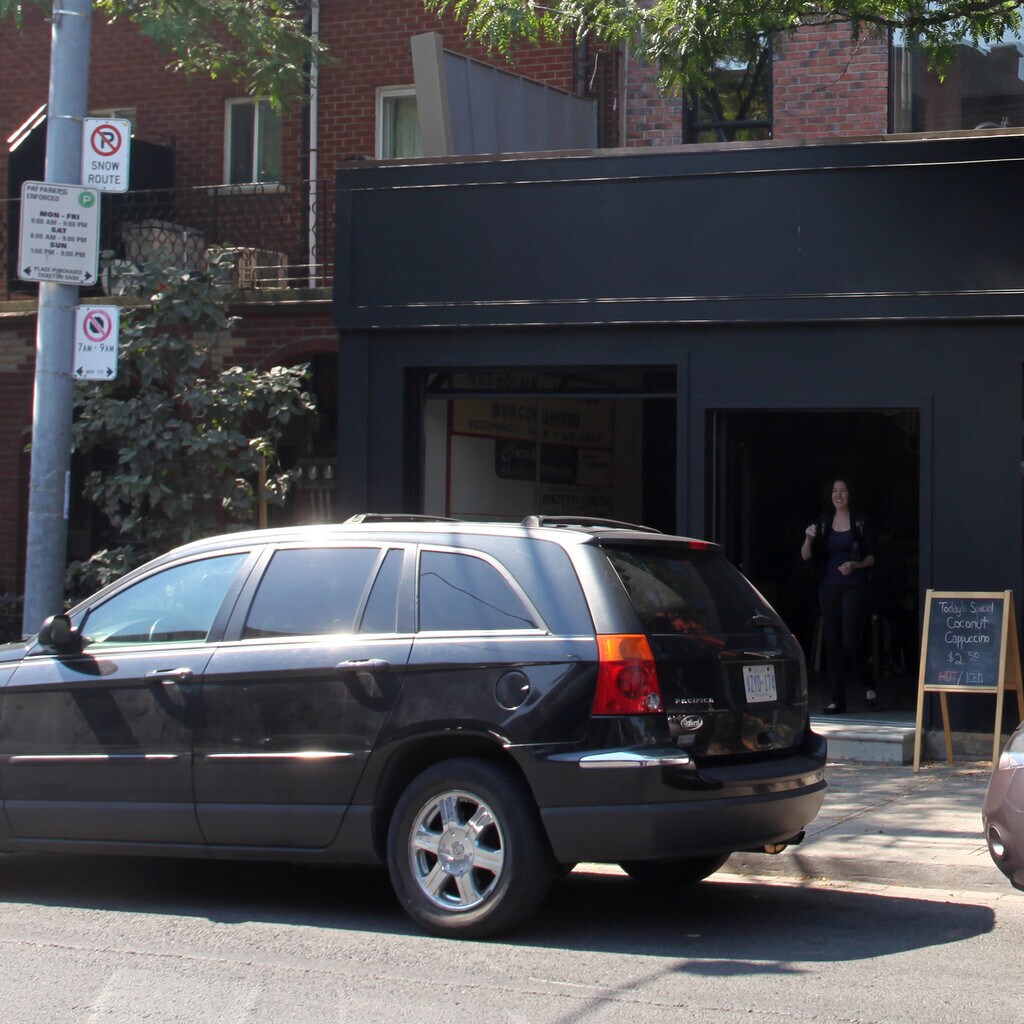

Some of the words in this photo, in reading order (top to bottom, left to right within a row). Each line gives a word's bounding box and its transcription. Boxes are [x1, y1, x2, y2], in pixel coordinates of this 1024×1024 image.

[91, 161, 119, 170] SNOW
[88, 174, 120, 184] ROUTE
[39, 187, 68, 195] PARKING
[26, 193, 60, 202] ENFORCED
[78, 343, 92, 352] 7AM
[100, 343, 114, 352] 9AM
[939, 601, 966, 617] Today's
[946, 616, 989, 629] Coconut
[944, 631, 990, 650] Cappuccino
